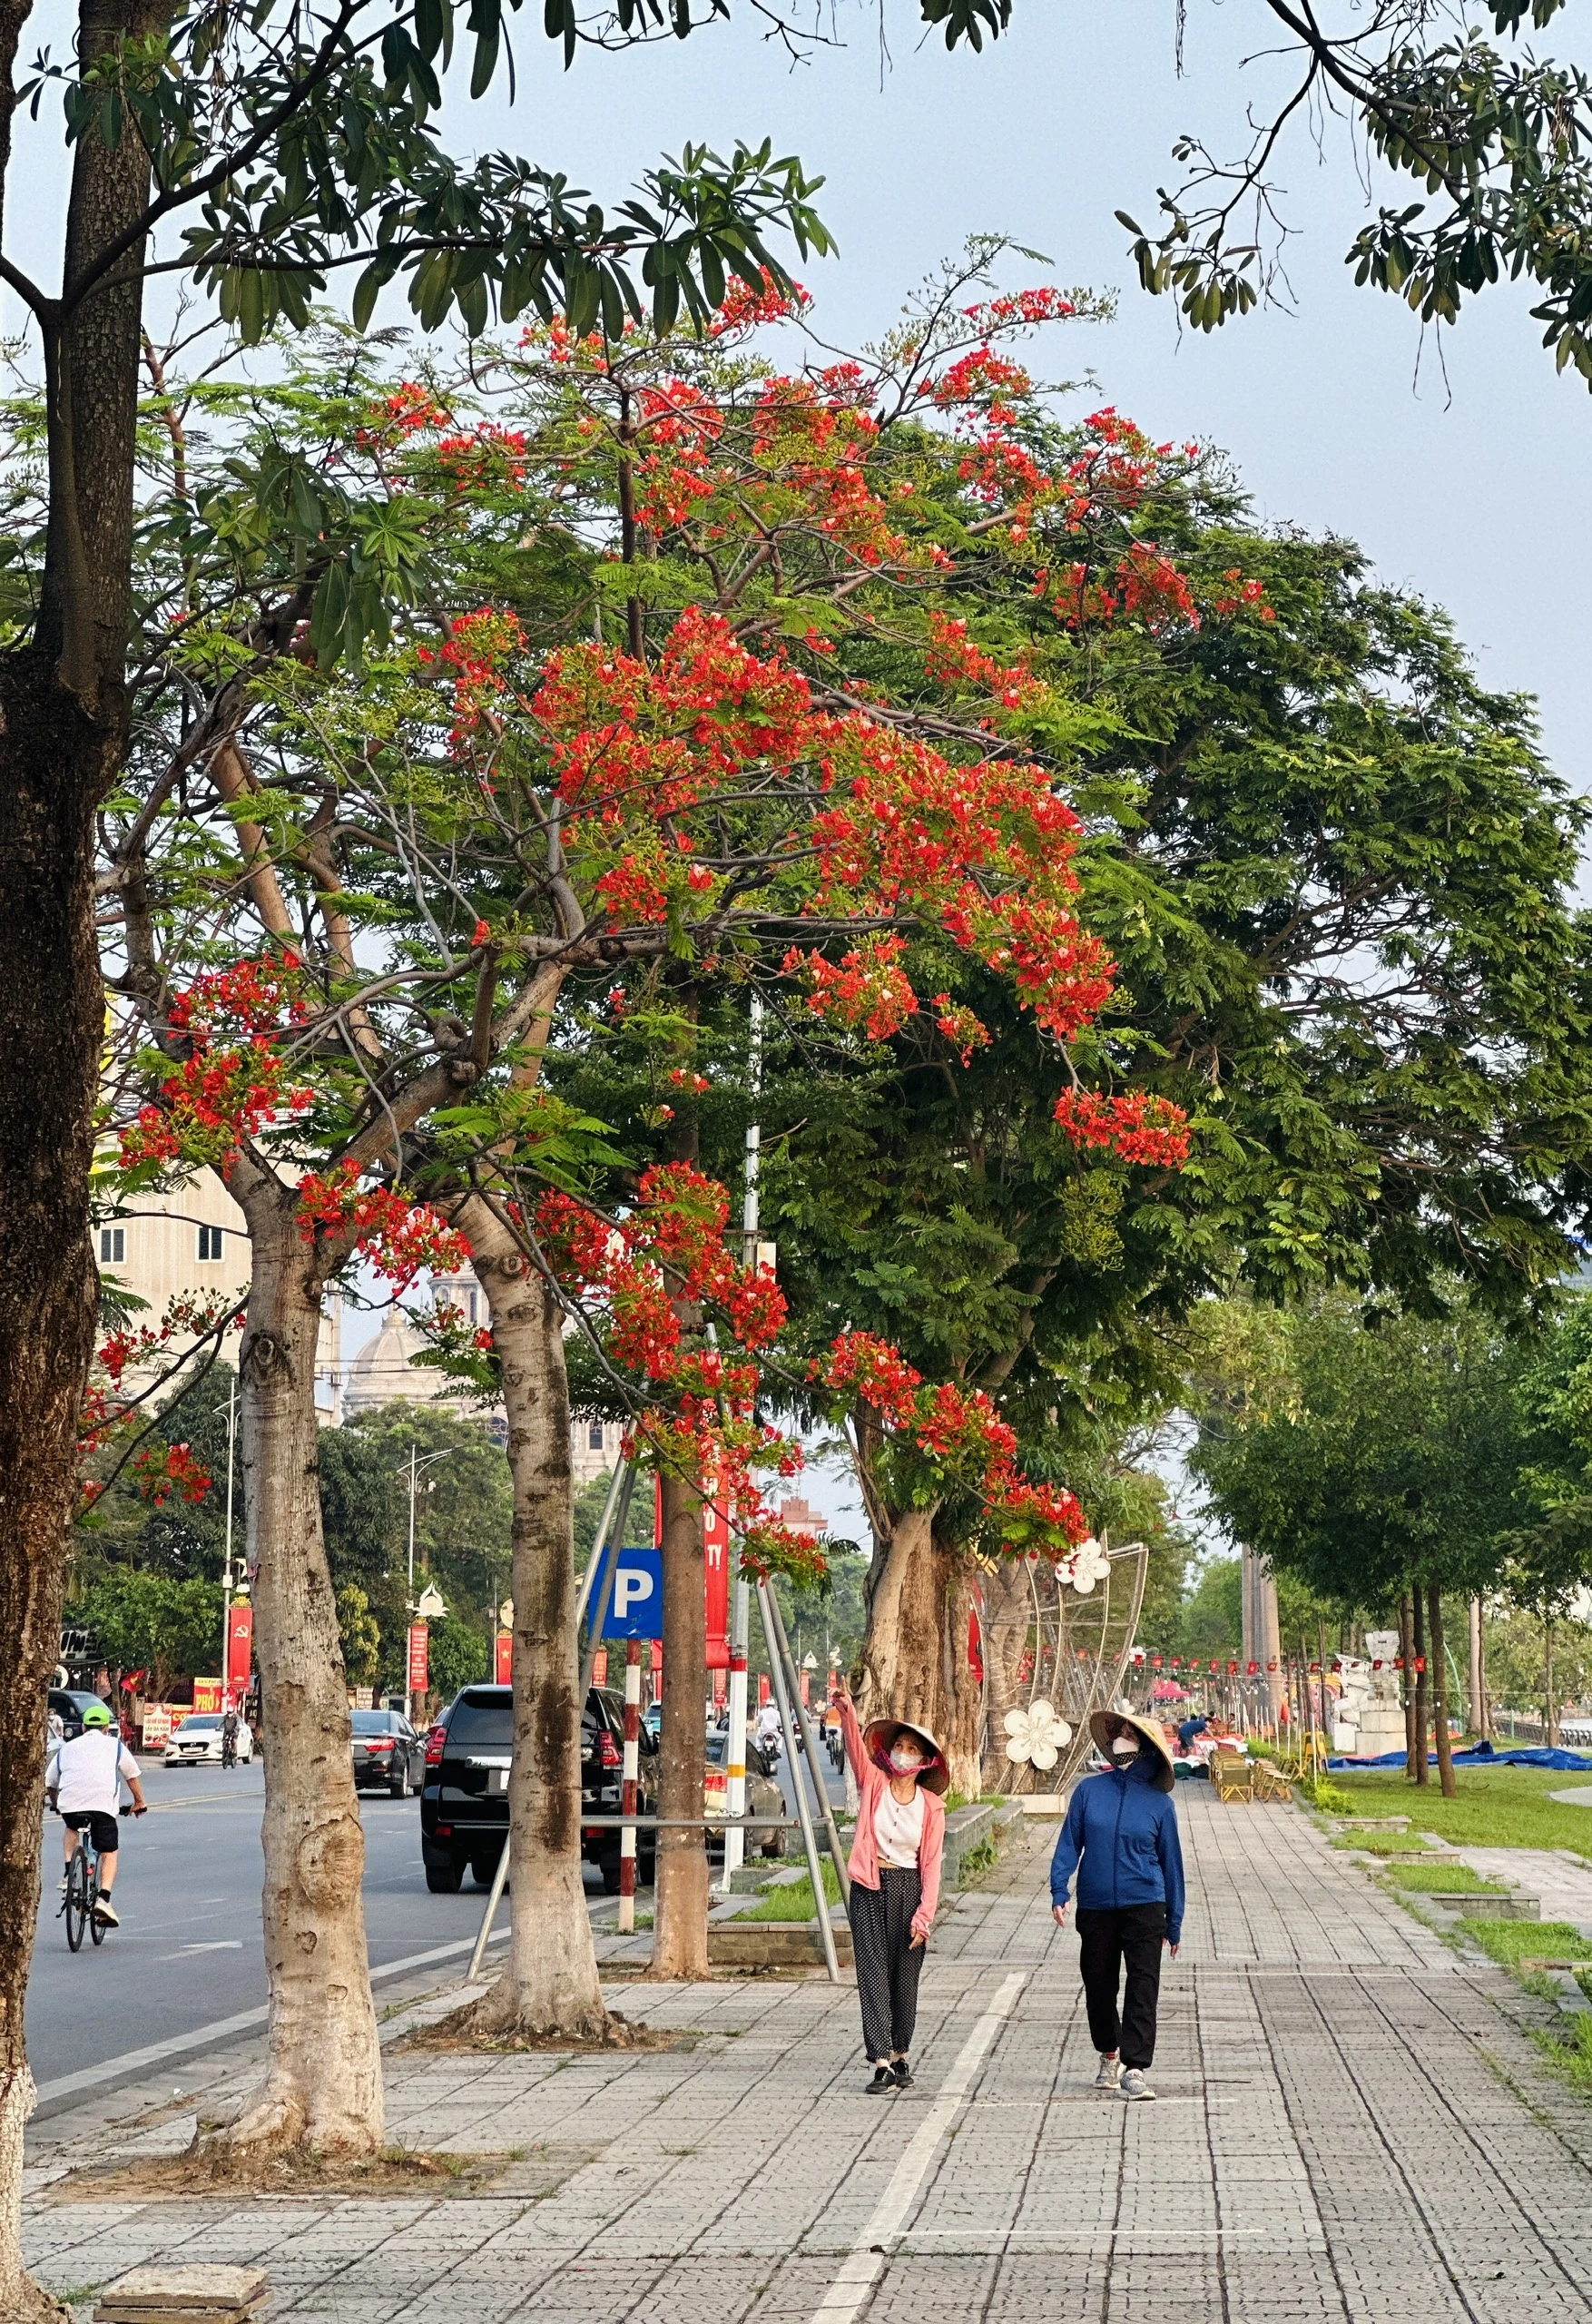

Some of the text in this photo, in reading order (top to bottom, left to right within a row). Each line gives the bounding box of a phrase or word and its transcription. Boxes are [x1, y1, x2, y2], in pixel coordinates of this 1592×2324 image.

[707, 1544, 722, 1571] TỴ
[614, 1569, 654, 1618] P
[194, 1687, 215, 1712] PHỞ
[172, 1712, 188, 1722] CƠ
